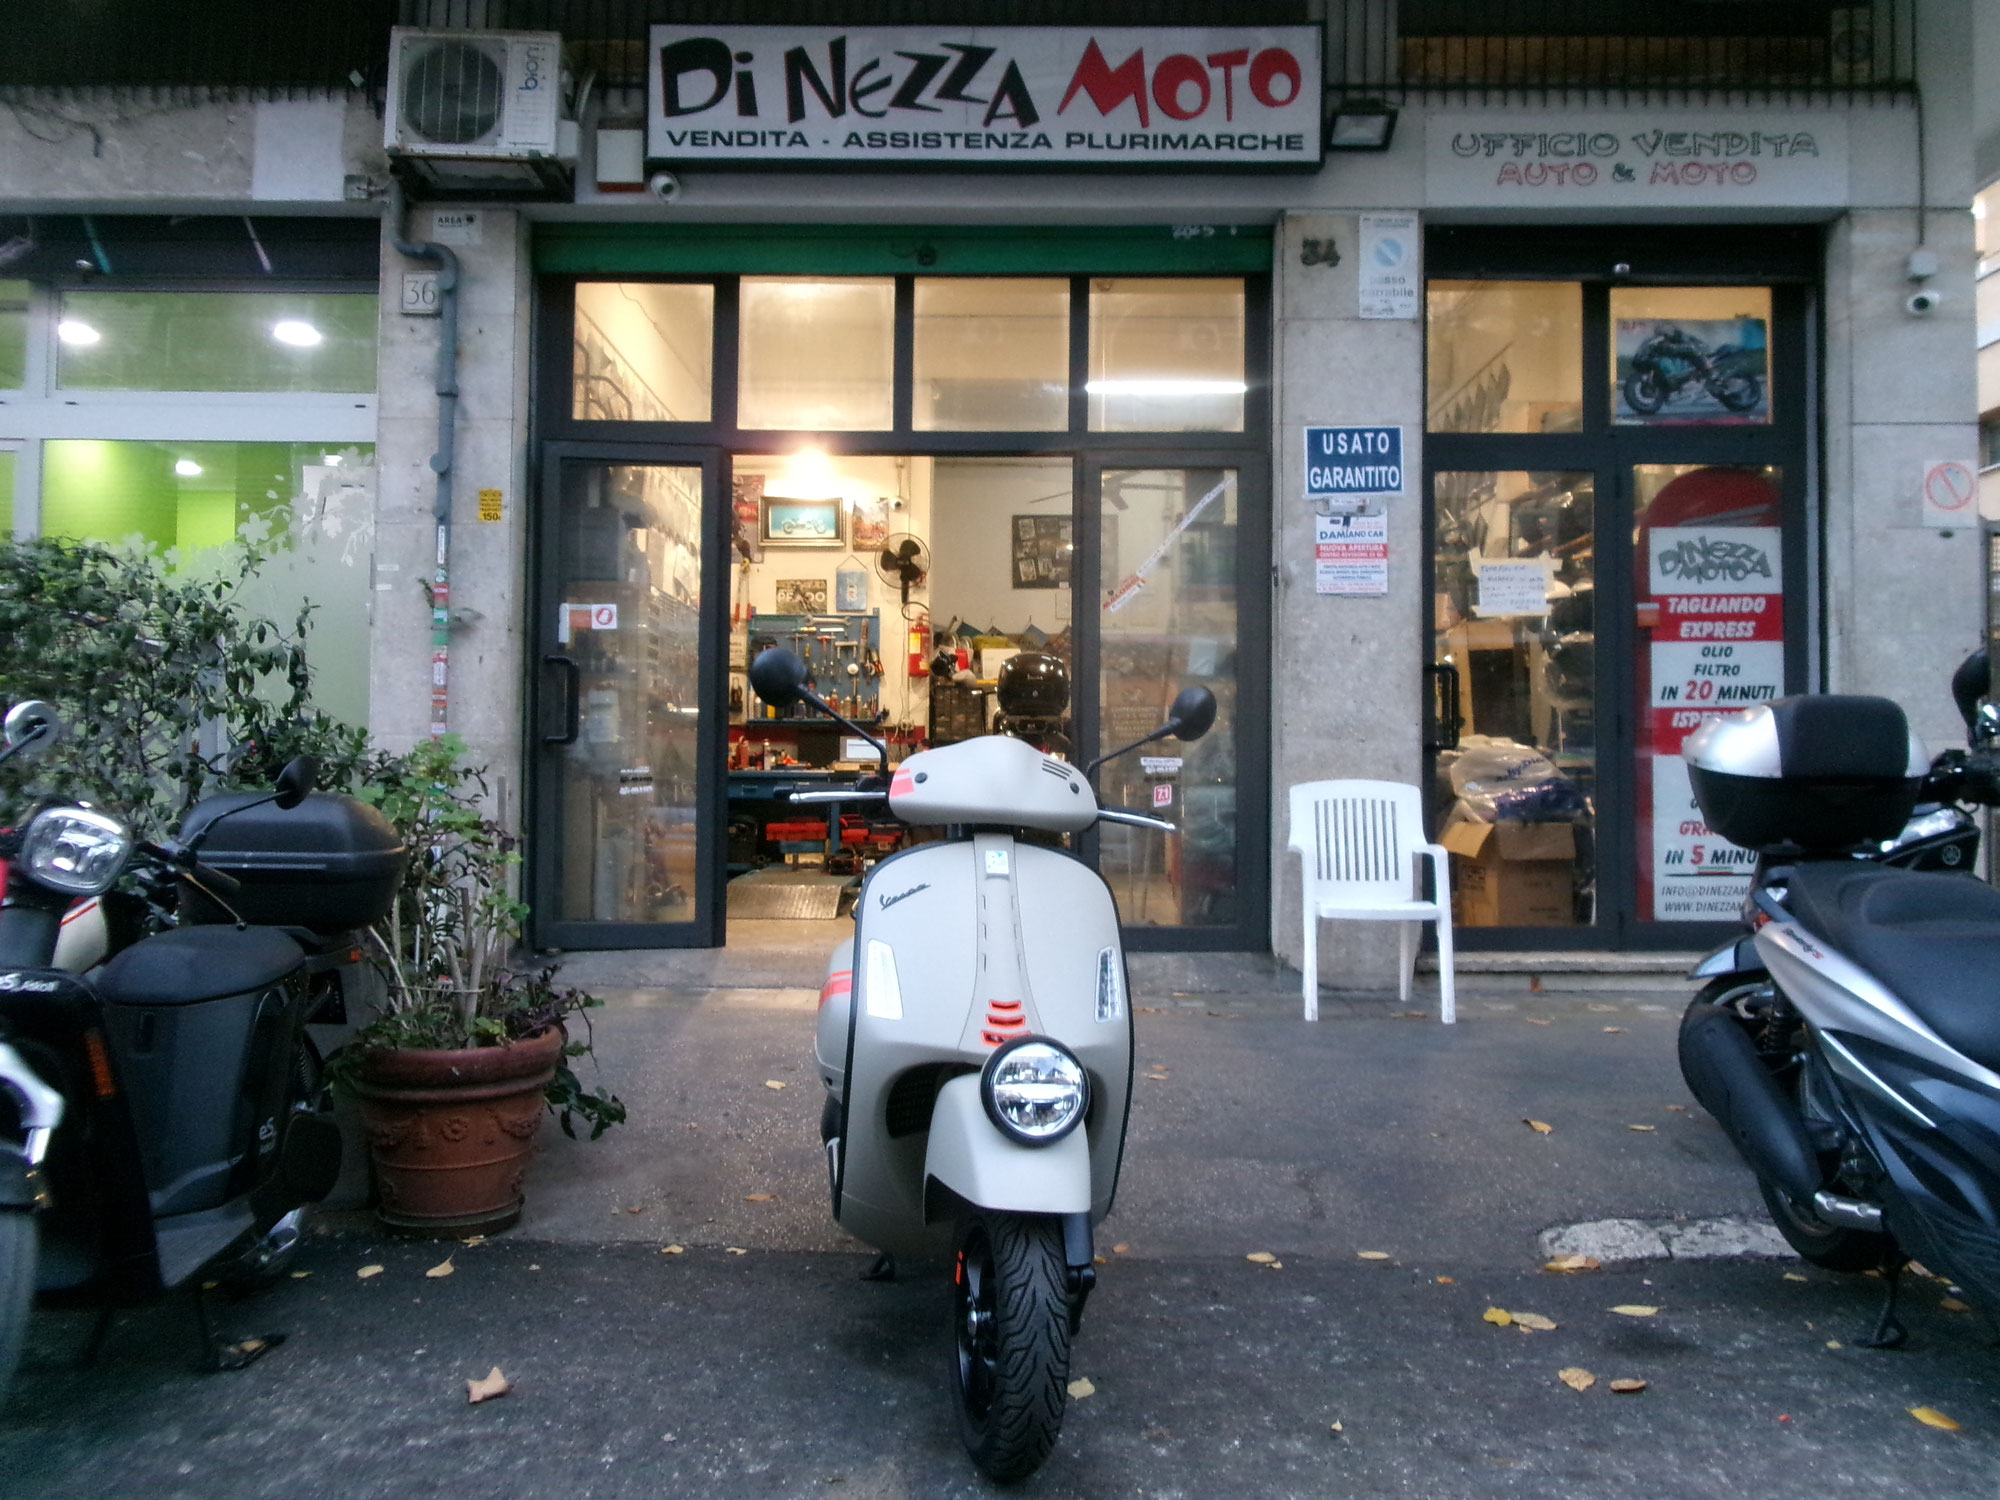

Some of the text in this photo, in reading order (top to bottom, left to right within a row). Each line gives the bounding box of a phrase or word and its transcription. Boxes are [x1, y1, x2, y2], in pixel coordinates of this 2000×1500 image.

[1057, 36, 1301, 128] MOTO
[666, 130, 809, 147] VENDITA
[843, 131, 1053, 150] ASSISTENZA
[1065, 132, 1304, 150] PLURIMARCHE
[1451, 129, 1819, 158] UFFICIO VENDITA
[1496, 161, 1757, 186] AUTO & MOTO
[438, 216, 463, 224] AREA
[405, 280, 436, 305] 36
[1323, 432, 1389, 454] USATO
[1310, 466, 1399, 488] GARANTITO
[1320, 530, 1366, 540] DAMIANO
[1668, 597, 1766, 613] TAGLIANDO
[1681, 621, 1756, 638] EXPRESS
[1702, 646, 1733, 657] OLIO
[1694, 664, 1740, 676] FILTRO
[1661, 680, 1776, 700] IN 20 MINUTI
[1665, 845, 1758, 865] IN 5 MINU
